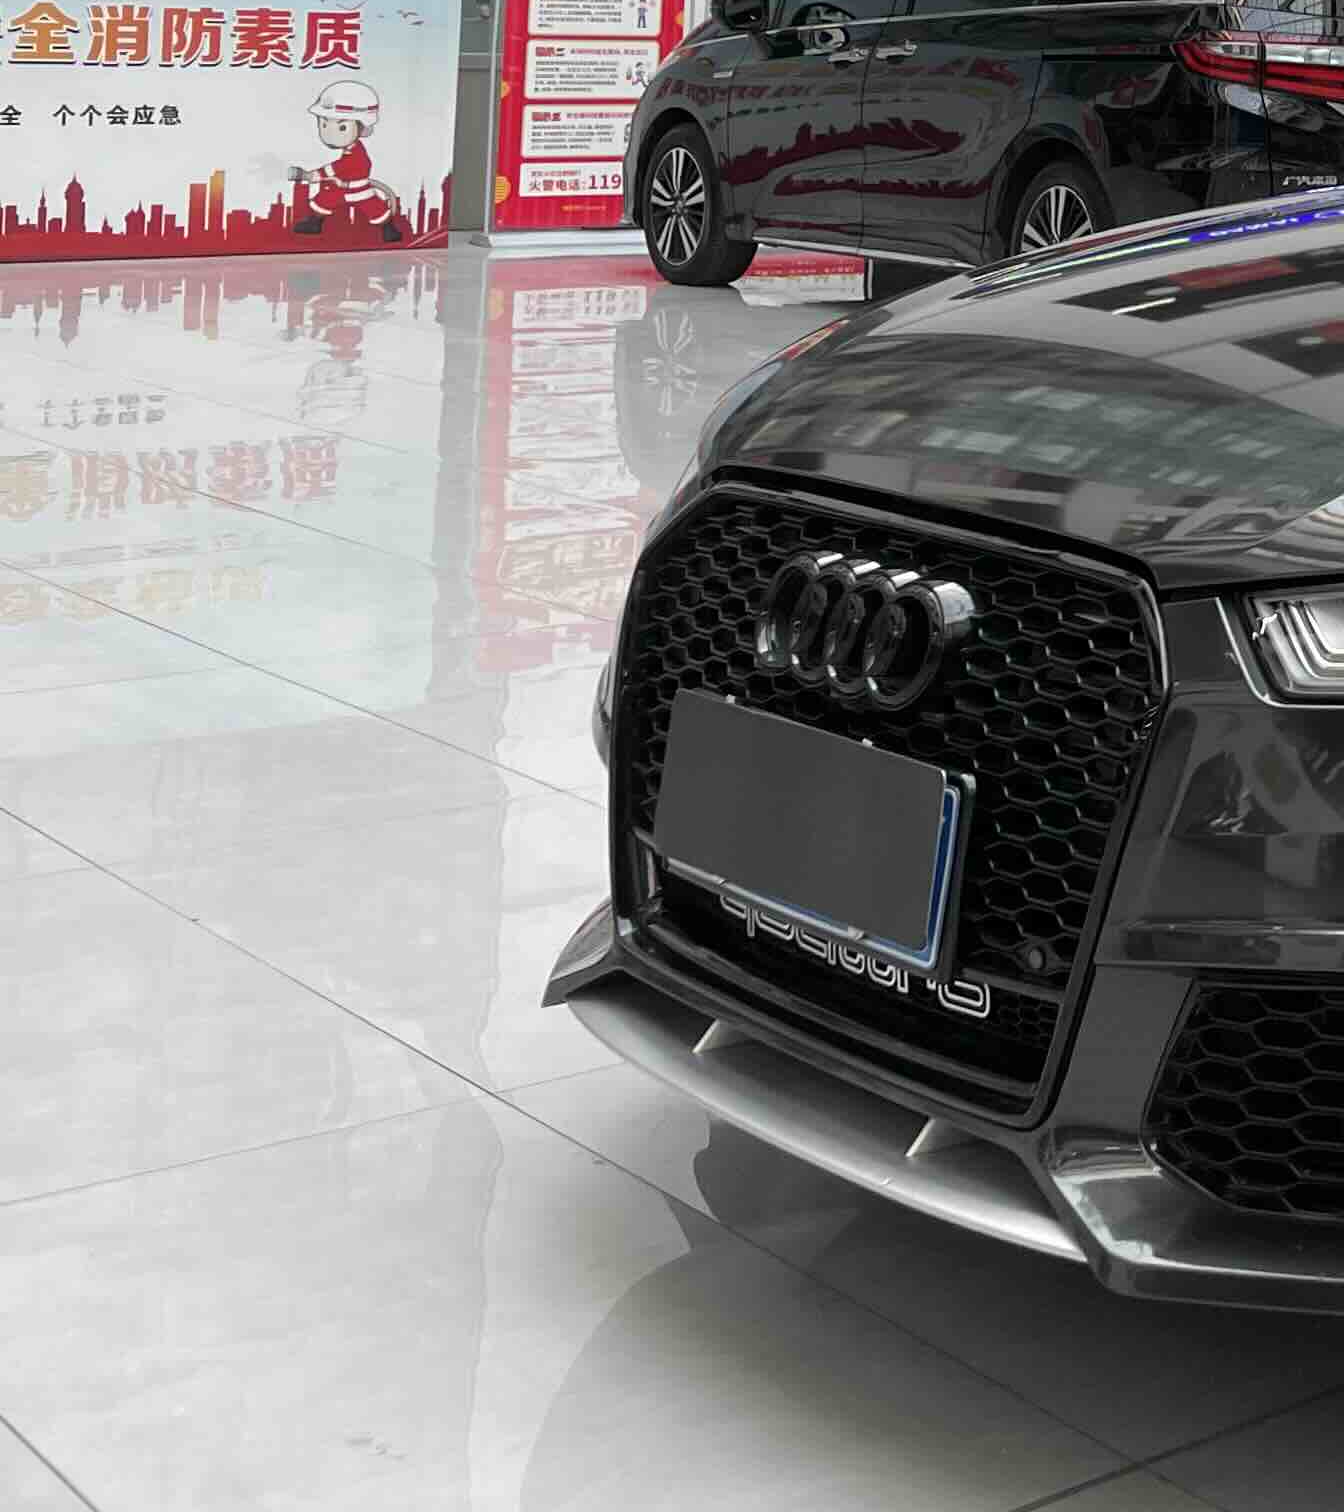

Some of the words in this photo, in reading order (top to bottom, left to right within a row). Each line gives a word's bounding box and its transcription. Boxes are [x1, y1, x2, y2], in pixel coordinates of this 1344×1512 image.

[0, 1, 362, 70] 全消防素质
[52, 104, 182, 127] 个个会应急
